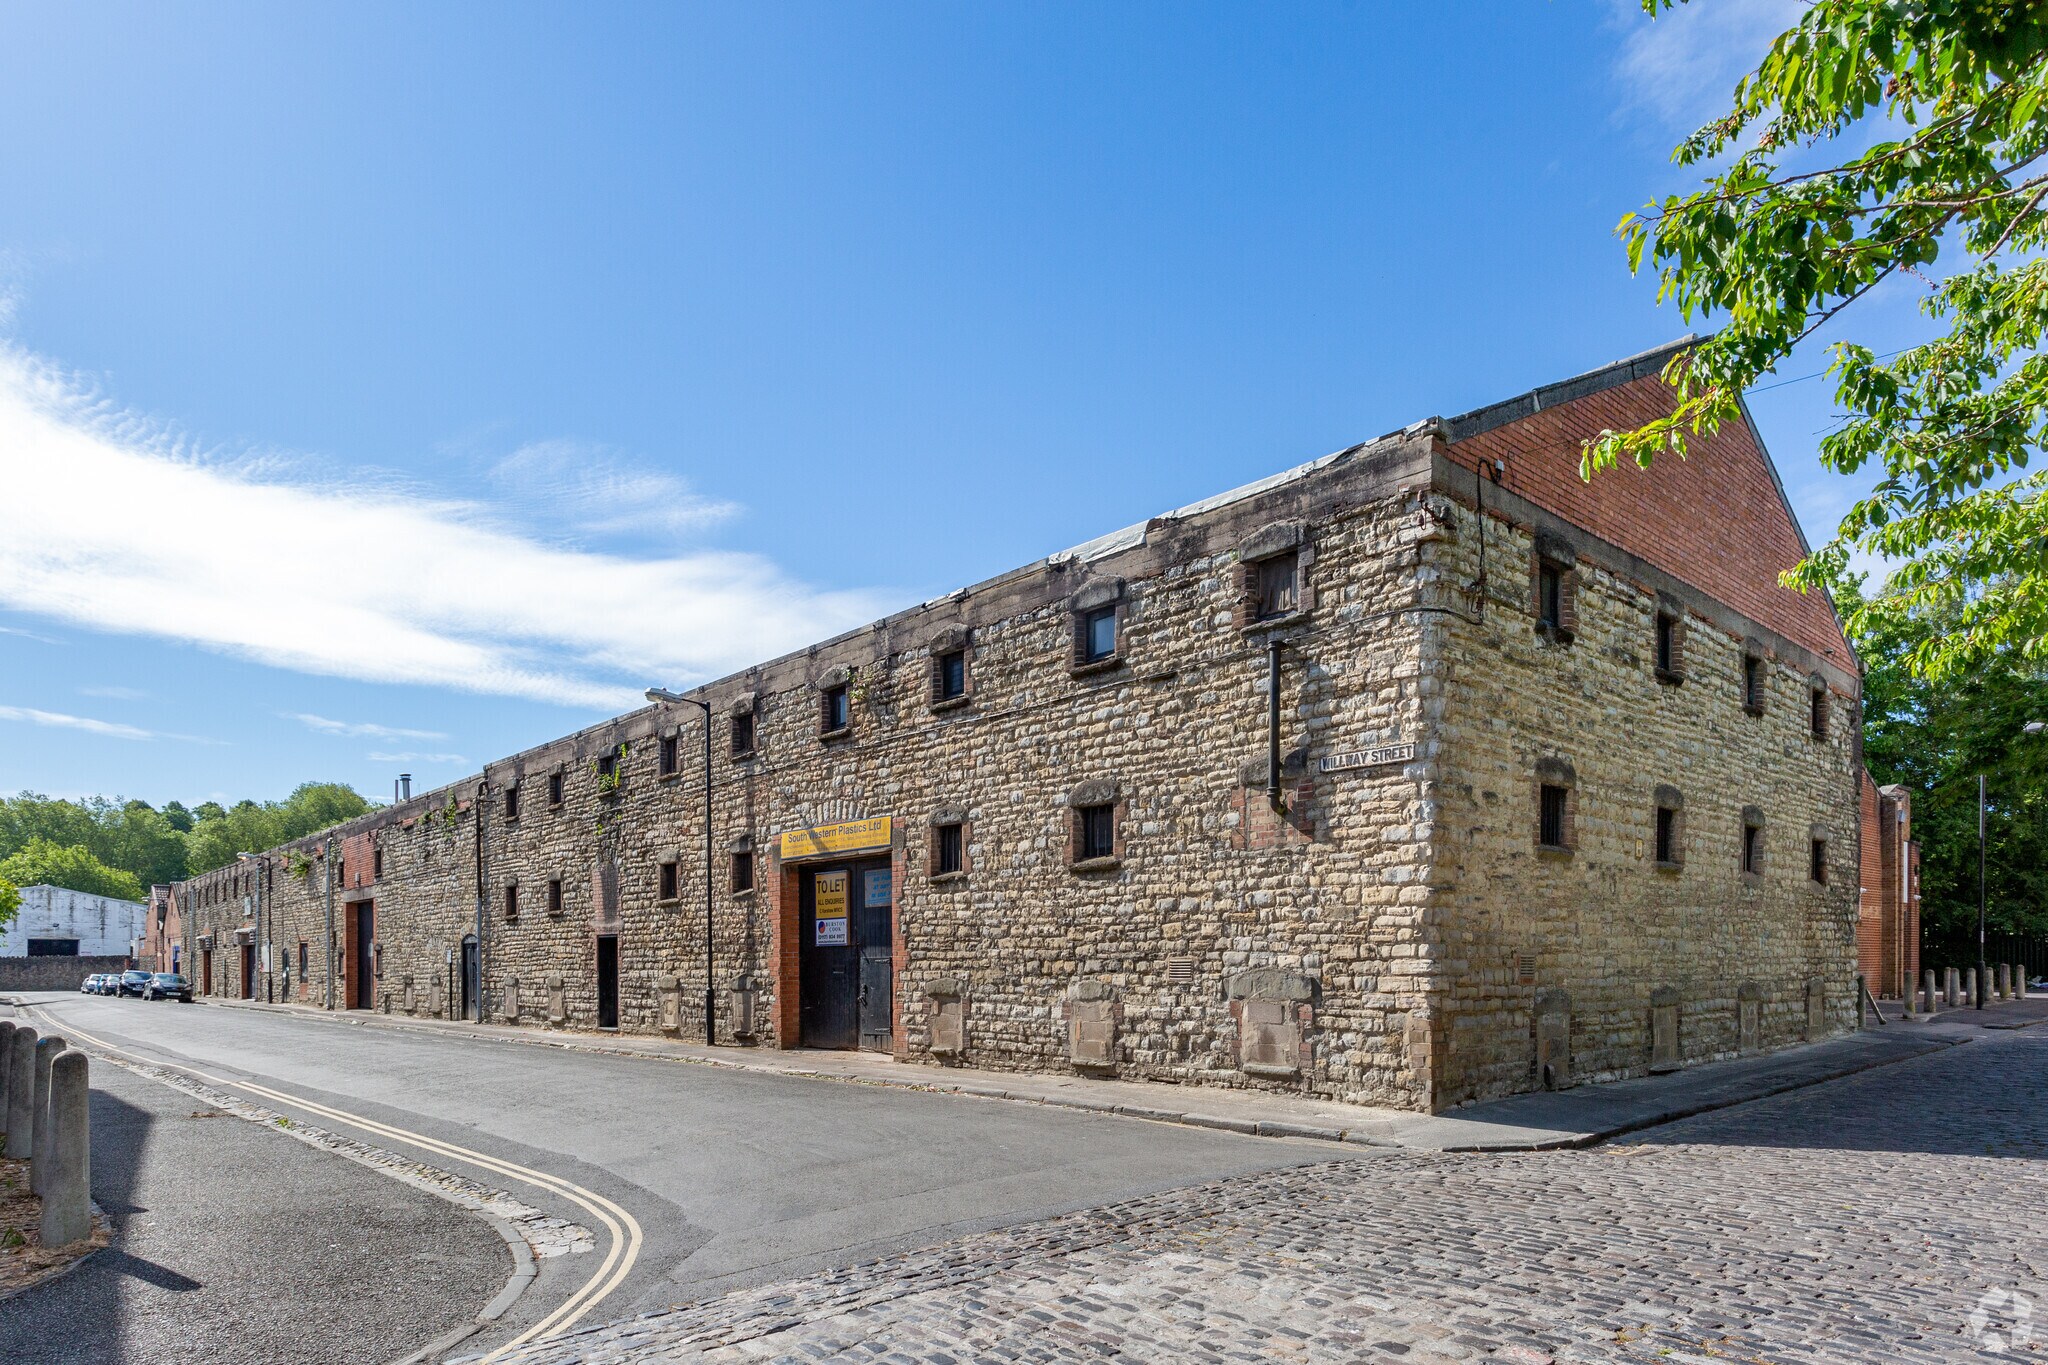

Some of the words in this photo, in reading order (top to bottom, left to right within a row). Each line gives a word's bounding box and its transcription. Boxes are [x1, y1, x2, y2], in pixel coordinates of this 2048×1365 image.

[1322, 753, 1368, 770] WILLWAY
[1371, 745, 1412, 763] STREET
[788, 833, 807, 843] South
[808, 828, 837, 839] Western
[838, 824, 867, 836] Plastics
[868, 820, 882, 831] Ltd
[817, 880, 828, 894] TO
[830, 878, 845, 892] LET
[817, 898, 825, 906] ALL
[824, 897, 845, 906] ENQUIRIES
